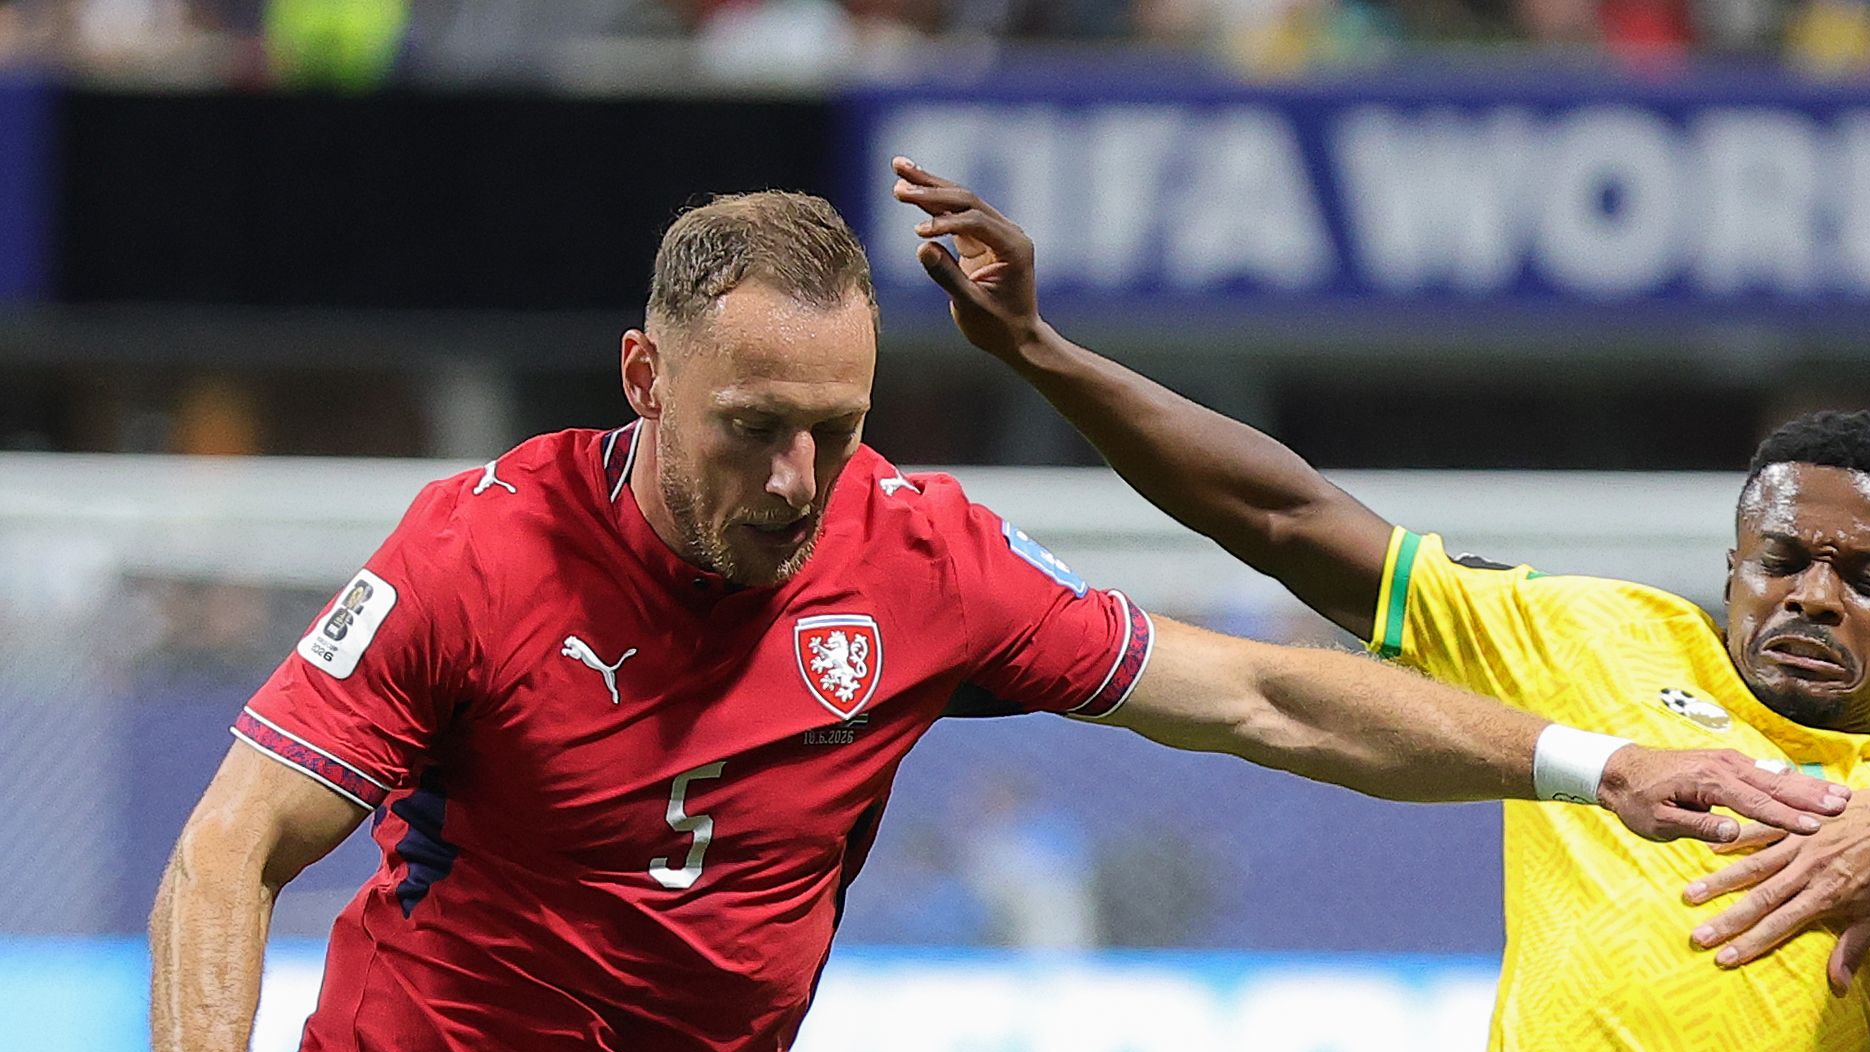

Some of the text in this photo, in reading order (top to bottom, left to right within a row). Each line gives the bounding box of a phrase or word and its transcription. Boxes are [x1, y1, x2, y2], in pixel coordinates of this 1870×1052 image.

[878, 103, 1333, 287] FIFA
[803, 730, 855, 745] 18.6.2026
[649, 761, 727, 888] 5
